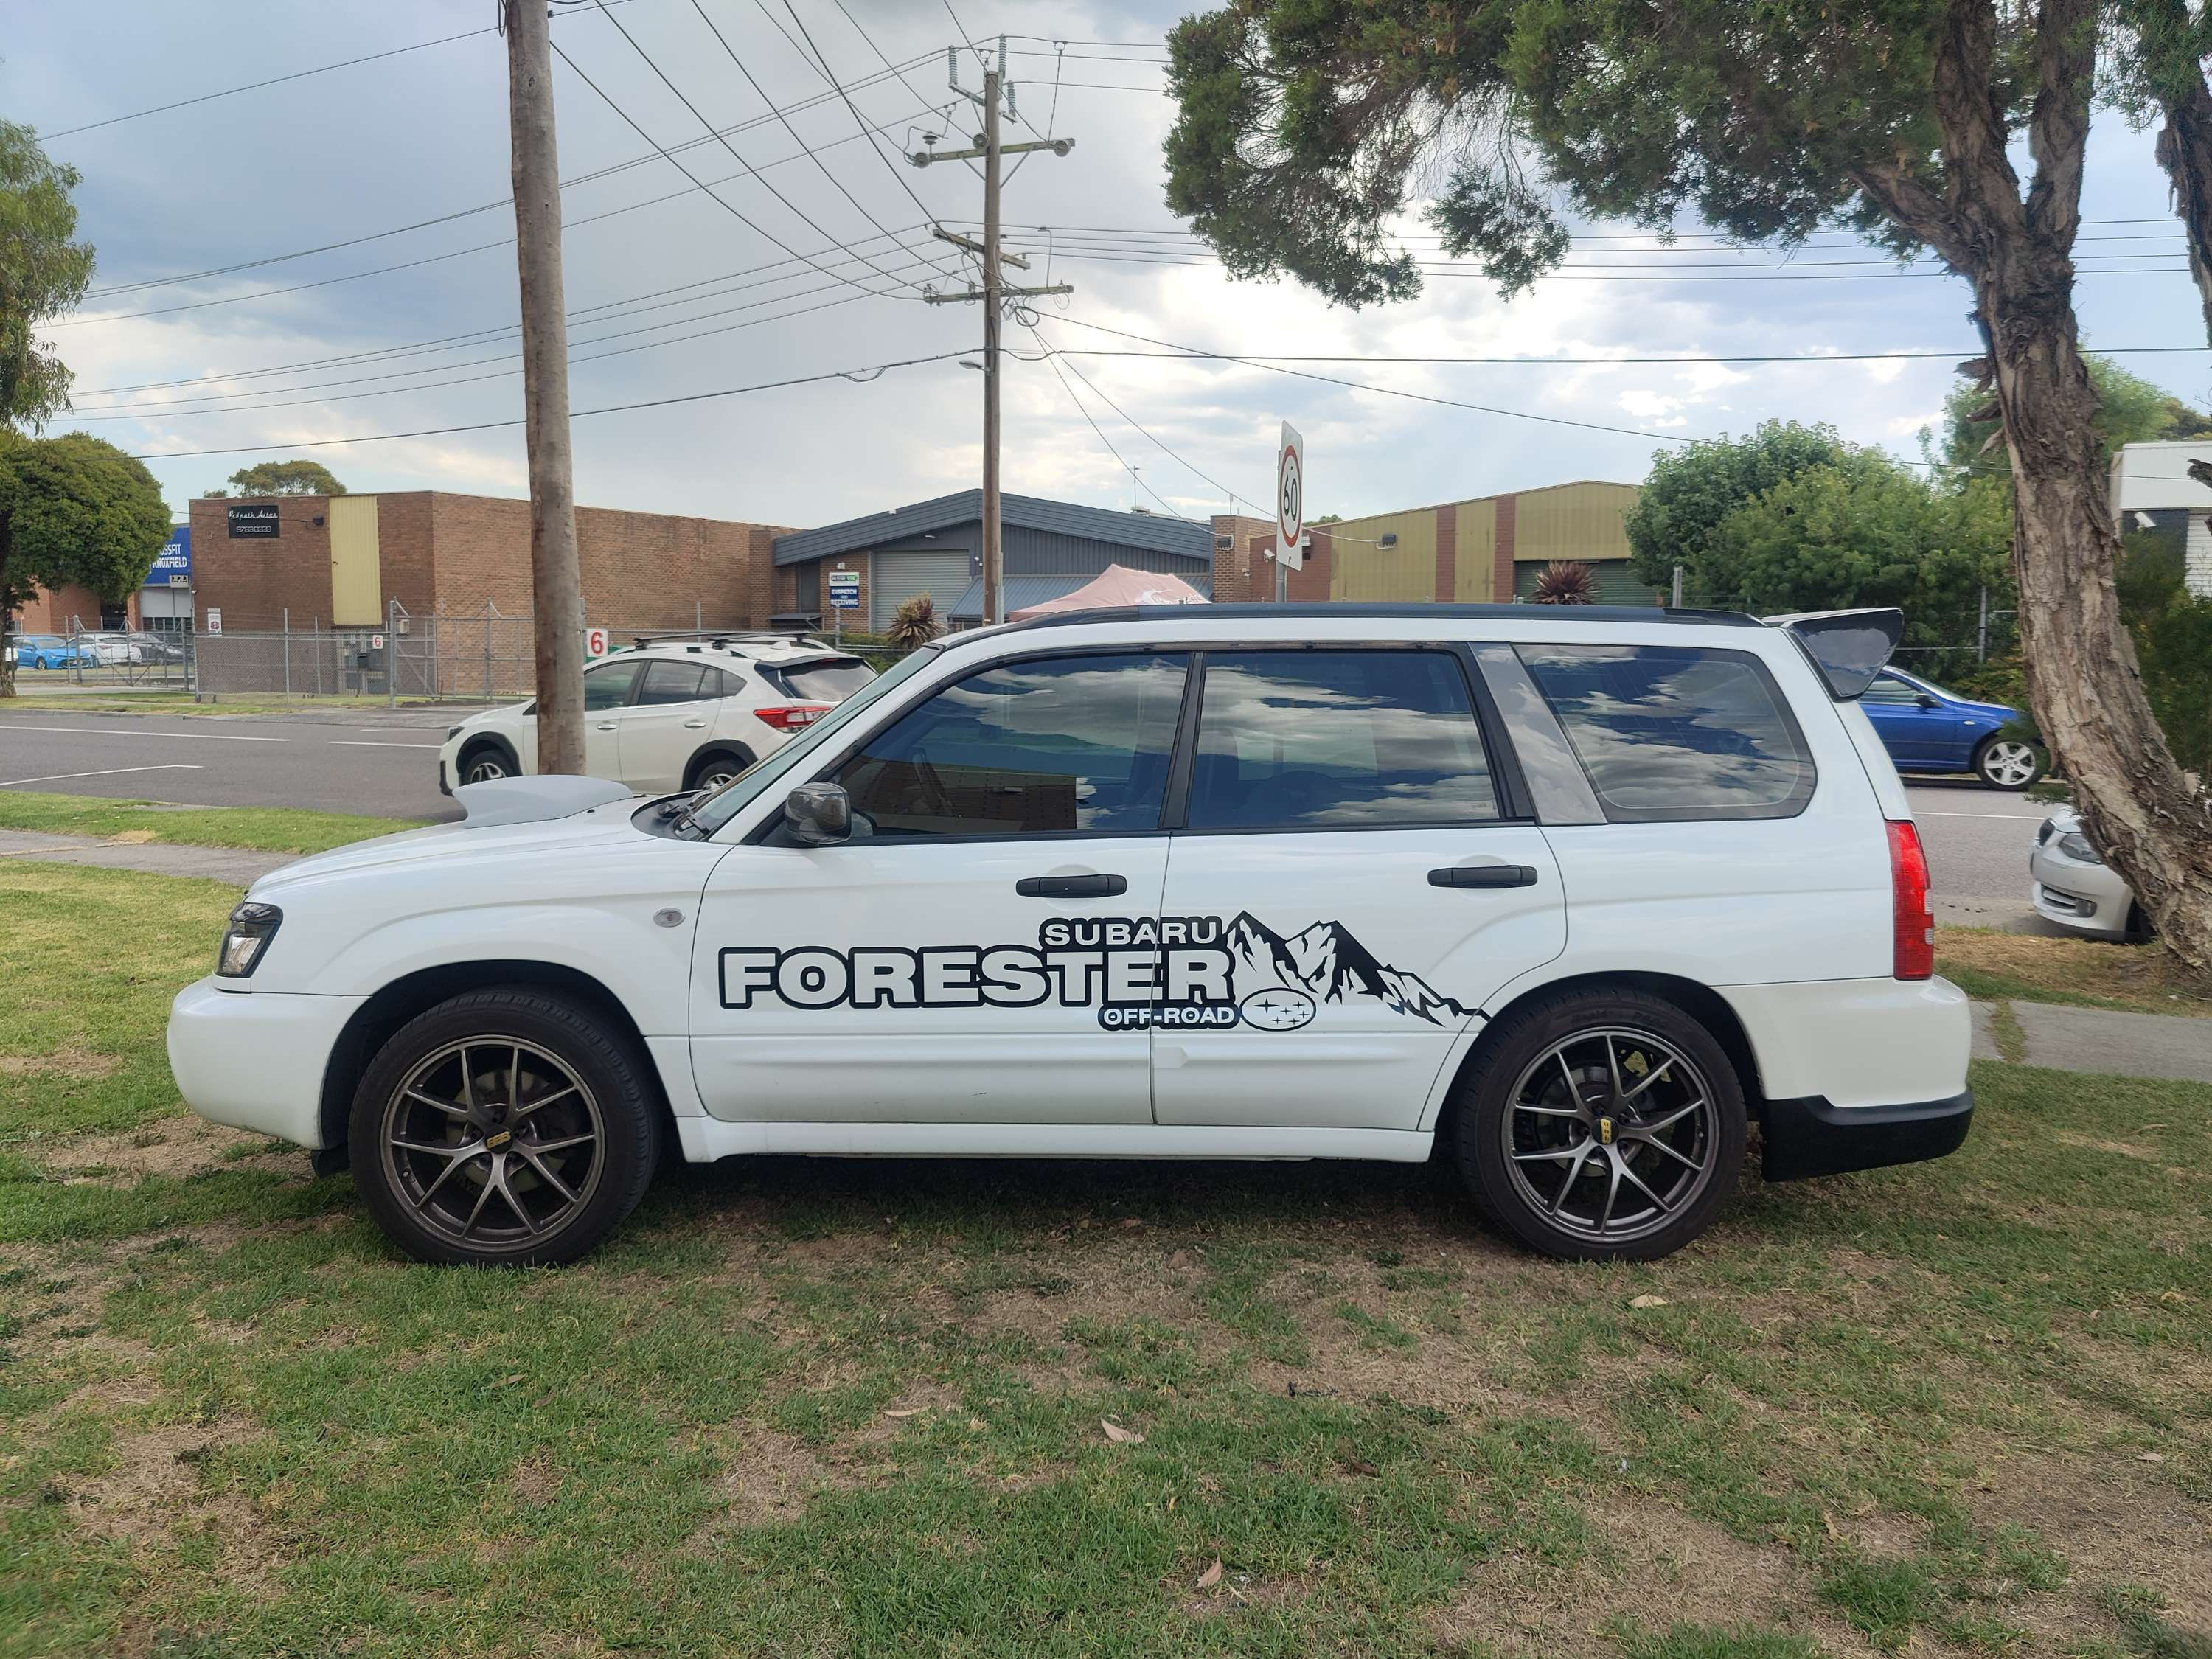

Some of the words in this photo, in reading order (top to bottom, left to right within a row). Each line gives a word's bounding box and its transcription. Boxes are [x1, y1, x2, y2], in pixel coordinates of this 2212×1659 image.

[1283, 474, 1298, 521] 60
[152, 557, 187, 568] KNOXFIELD
[210, 622, 220, 630] 8
[375, 637, 381, 647] 6
[591, 631, 603, 655] 6
[1043, 921, 1217, 947] SUBARU
[720, 946, 1234, 1008] FORESTER
[1102, 1006, 1237, 1026] OFF-ROAD
[487, 1131, 511, 1148] BBS
